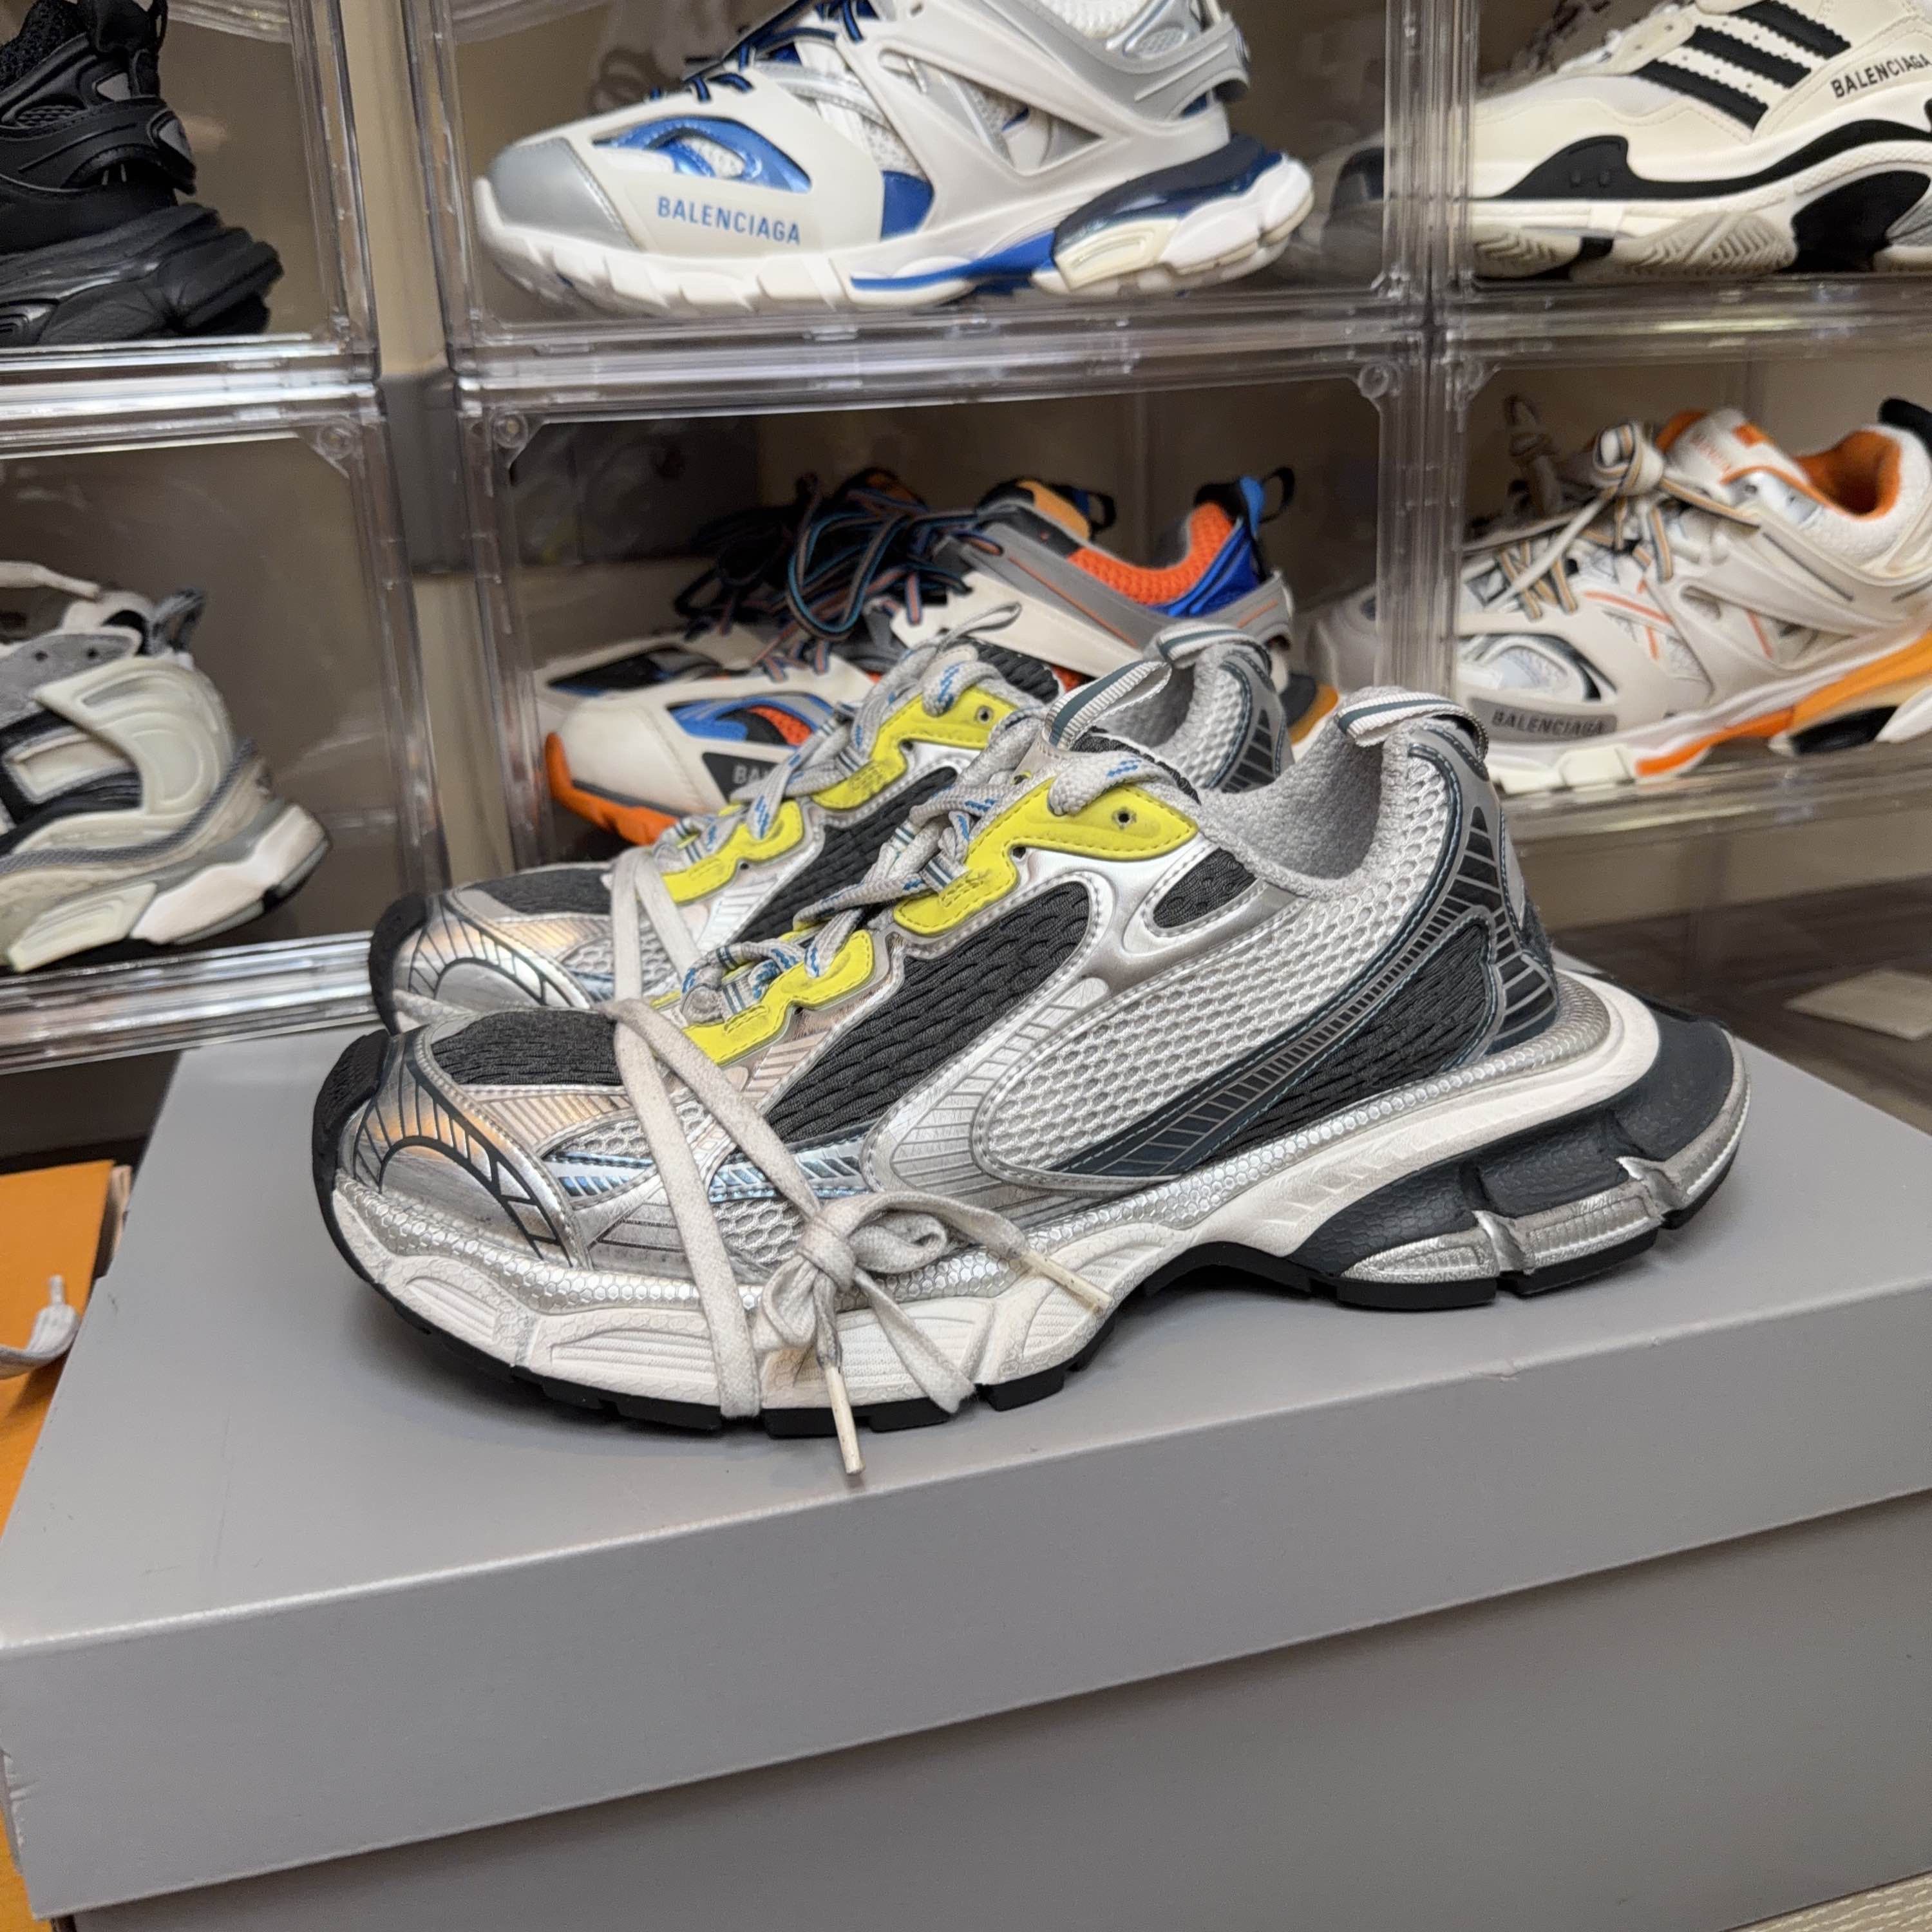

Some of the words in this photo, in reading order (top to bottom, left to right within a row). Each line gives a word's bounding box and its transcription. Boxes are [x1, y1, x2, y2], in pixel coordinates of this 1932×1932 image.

[1831, 53, 1931, 98] BALENCIAGA
[658, 196, 800, 245] BALENCIAGA
[1492, 710, 1605, 737] BALENCIAGA
[734, 764, 771, 784] BA
